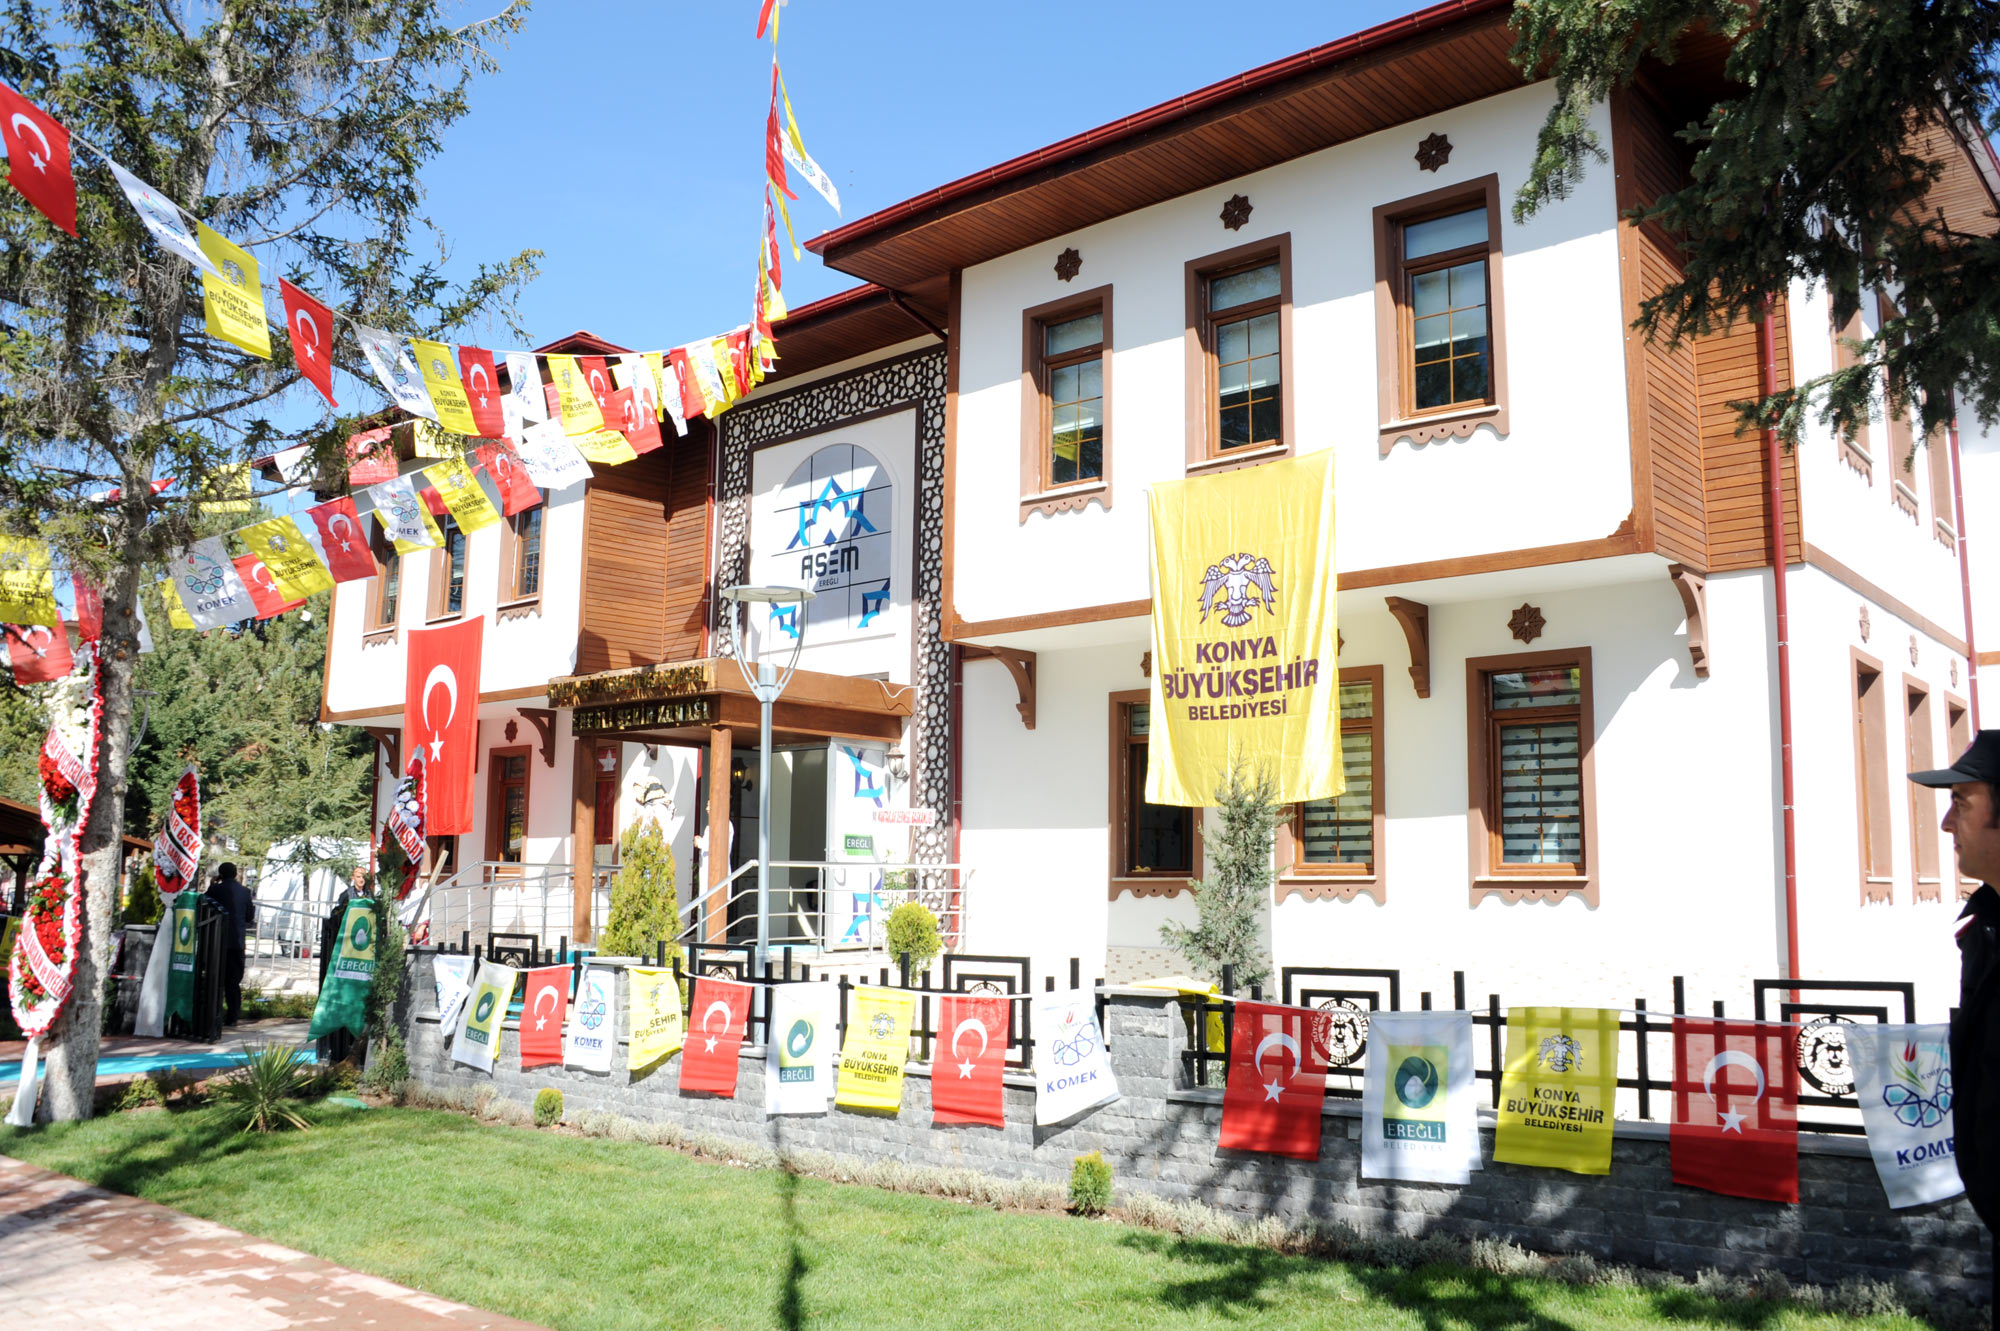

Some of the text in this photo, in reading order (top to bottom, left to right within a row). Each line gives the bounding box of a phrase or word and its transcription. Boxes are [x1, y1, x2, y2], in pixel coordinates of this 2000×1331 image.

[222, 289, 249, 309] KONYA
[801, 546, 860, 580] ASEM
[196, 596, 236, 614] KOMEK
[1196, 636, 1278, 664] KONYA
[1164, 655, 1319, 700] BÜYÜKŞEHİR
[1188, 694, 1287, 721] BELEDİYESİ
[574, 1035, 603, 1049] KOMEK
[843, 1057, 899, 1077] BÜYÜKŞEHİR
[861, 1051, 888, 1062] KONYA
[1047, 1069, 1097, 1094] KOMEK
[1534, 1087, 1581, 1104] KONYA
[1506, 1097, 1604, 1124] BÜYÜKŞEHİR
[1524, 1117, 1583, 1133] BELEDİYESİ
[1896, 1137, 1956, 1166] KOME
